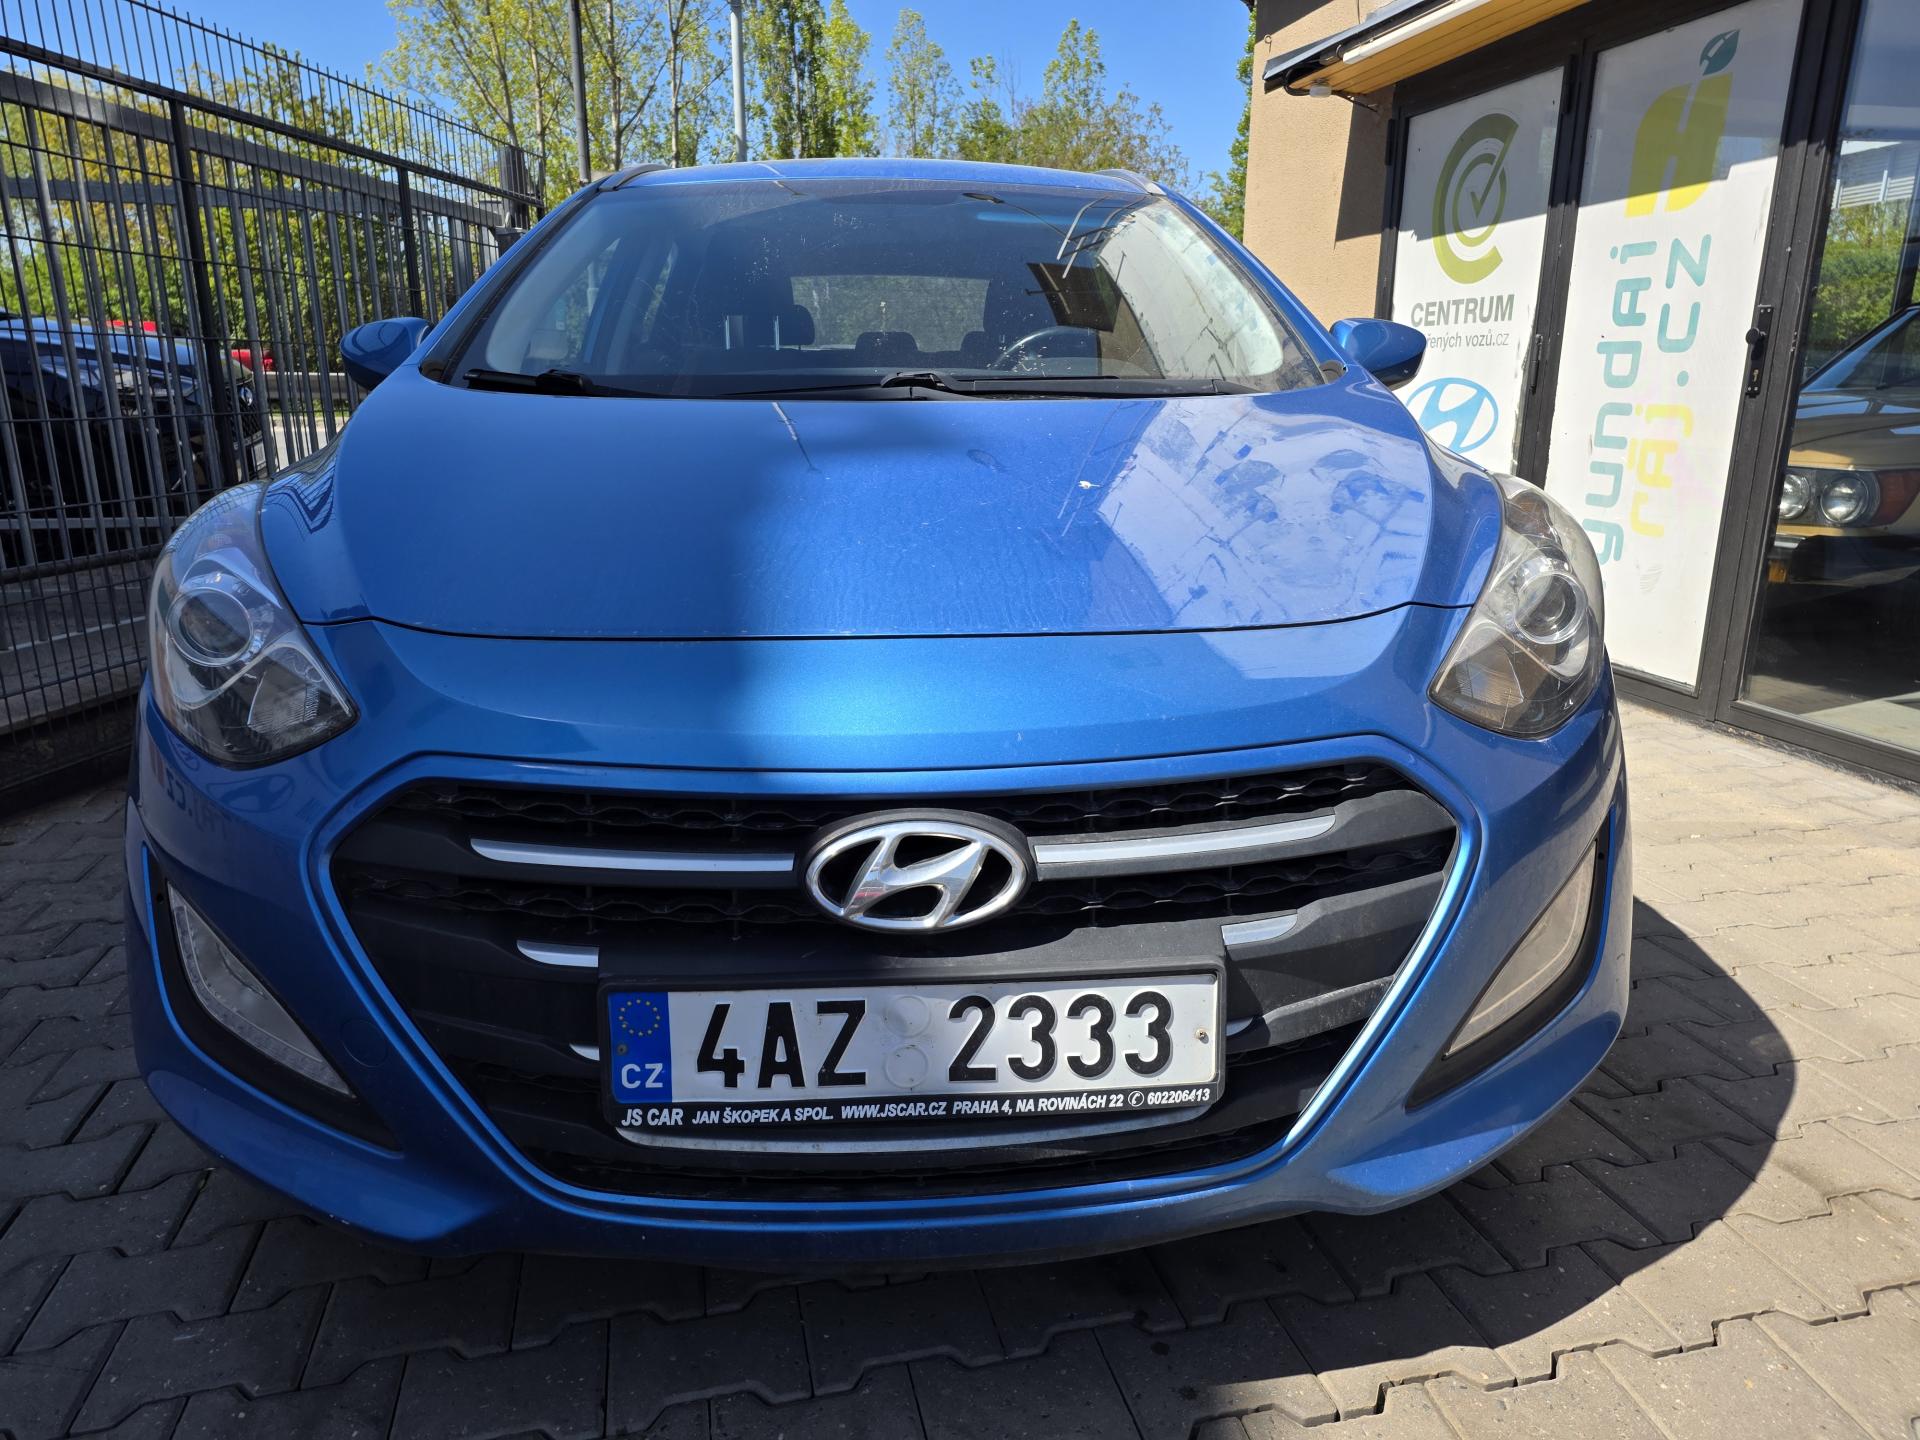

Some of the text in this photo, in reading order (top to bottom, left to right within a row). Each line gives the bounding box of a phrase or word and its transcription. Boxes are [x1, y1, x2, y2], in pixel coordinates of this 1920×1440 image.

[1410, 294, 1515, 328] CENTRUM
[1426, 332, 1462, 352] řených
[696, 989, 1173, 1089] 4AZ 2333
[621, 1062, 664, 1089] CZ
[621, 1087, 1211, 1127] JS CAR JAN ŠKOPEK A SPOL. WWW.JSCAR.CZ PRAHA 4, NA ROVINÁCH 22 602206413
